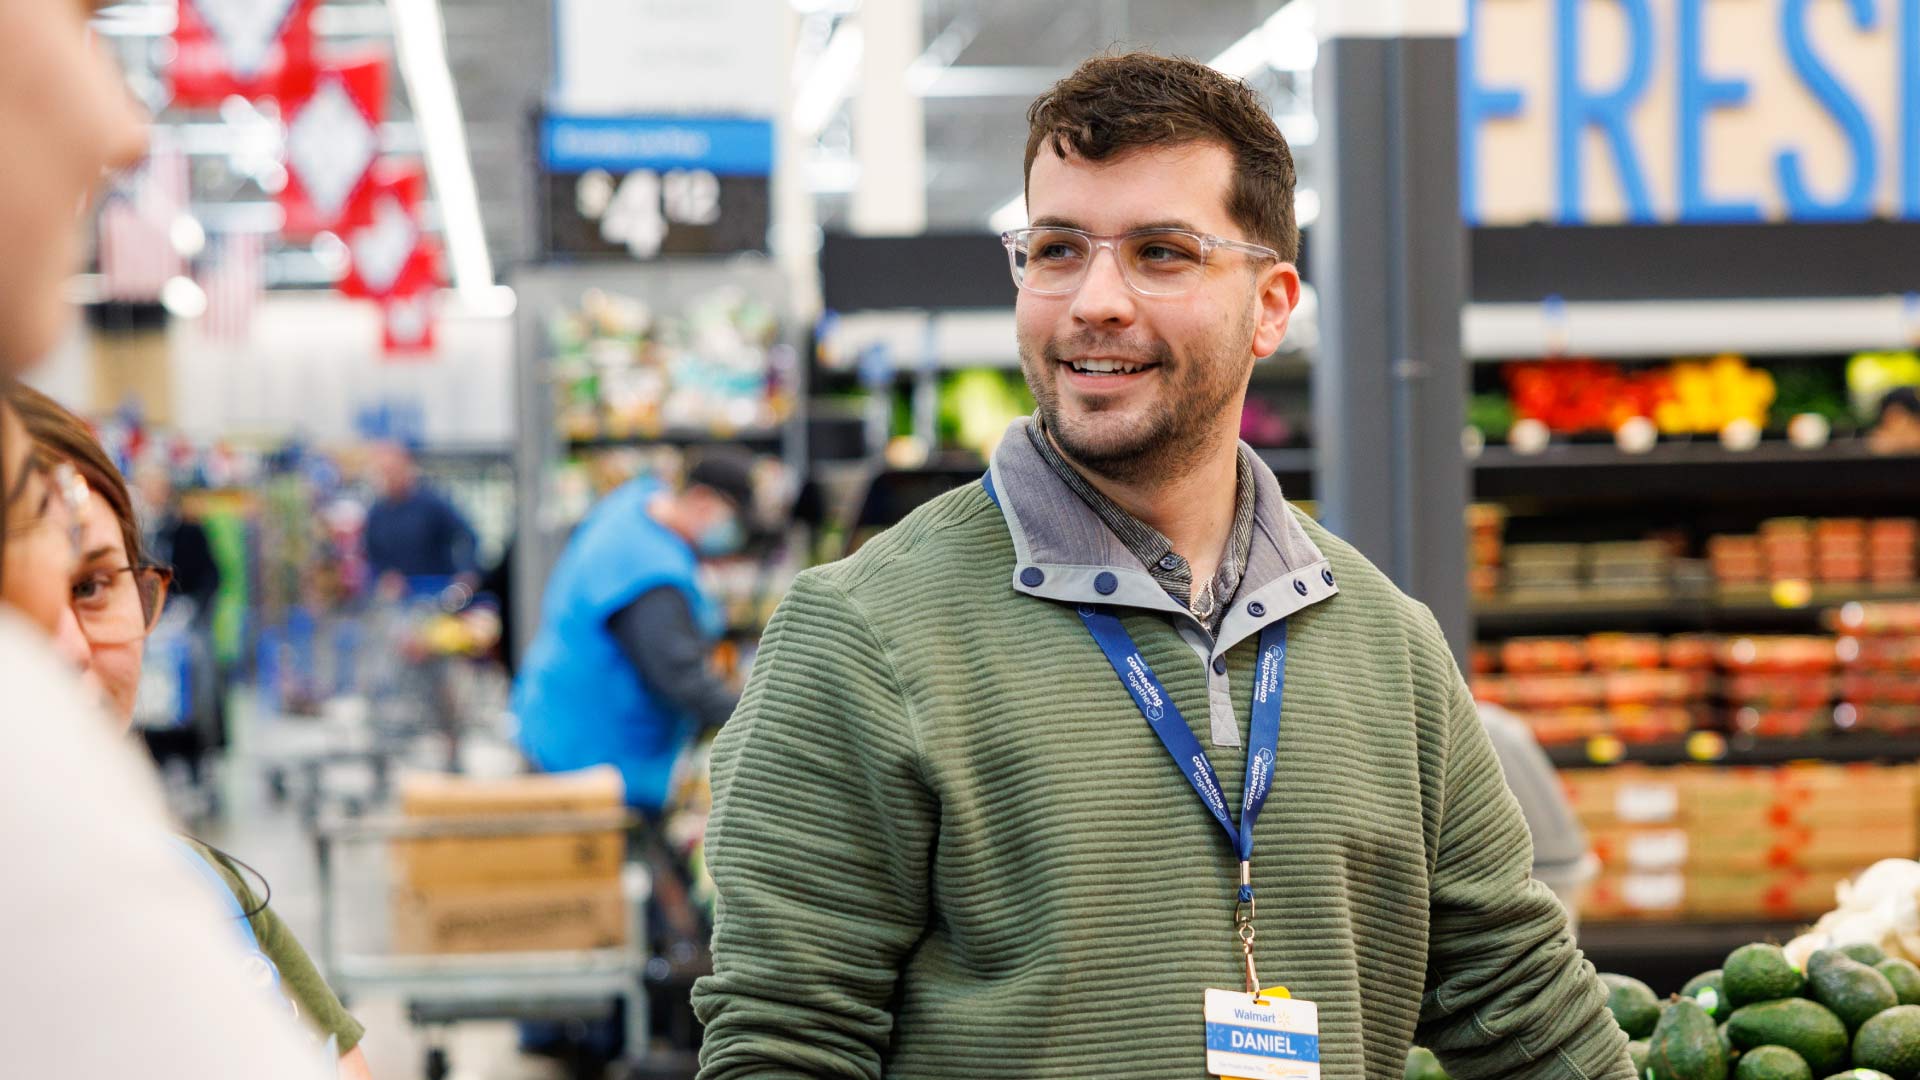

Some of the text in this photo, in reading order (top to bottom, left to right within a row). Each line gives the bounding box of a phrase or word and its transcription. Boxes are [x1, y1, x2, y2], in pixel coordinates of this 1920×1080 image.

[1127, 656, 1163, 707] connecting
[1128, 671, 1153, 705] together
[1260, 651, 1273, 703] connecting
[1269, 658, 1278, 693] together
[1192, 755, 1224, 809] connecting
[1193, 771, 1218, 807] together
[1247, 755, 1263, 811] connecting
[1255, 762, 1268, 799] together
[1234, 1008, 1276, 1023] Walmart
[1231, 1030, 1297, 1055] DANIEL
